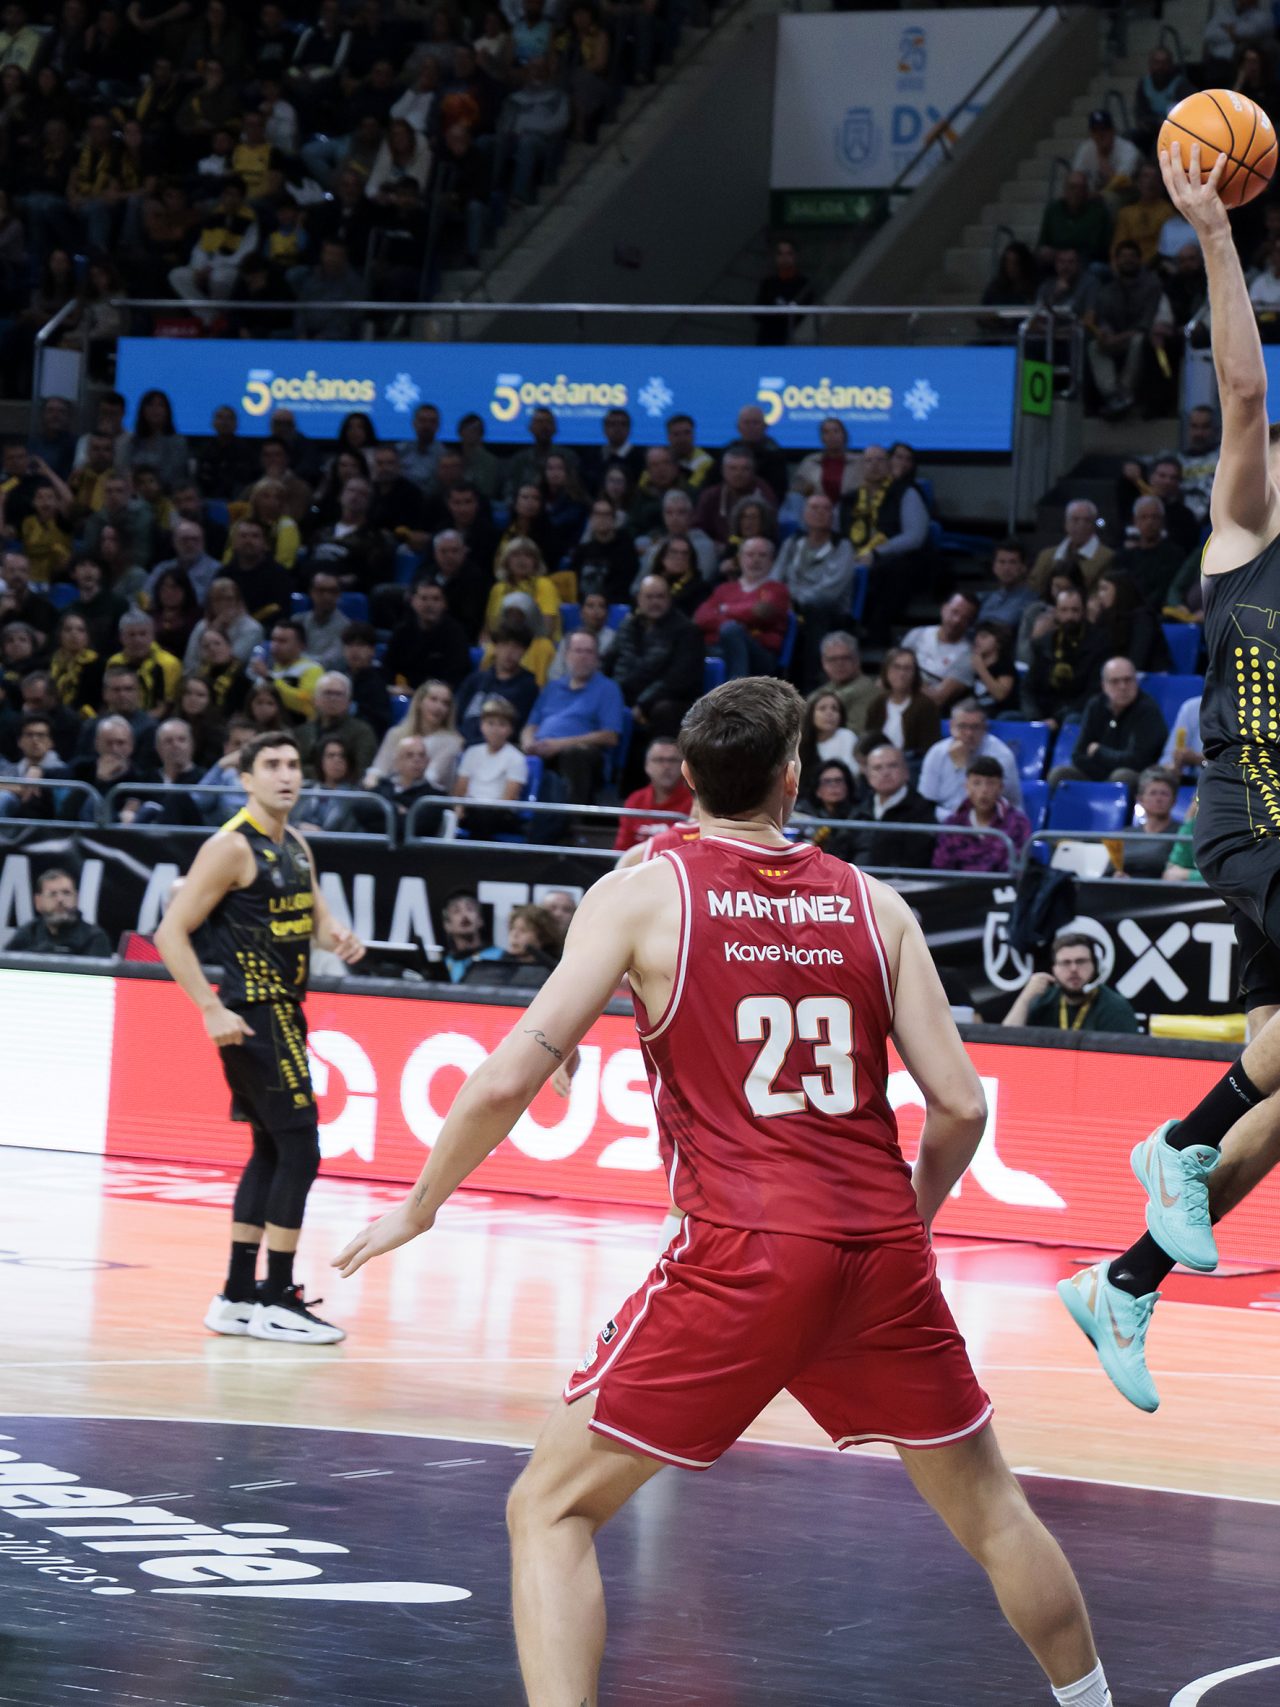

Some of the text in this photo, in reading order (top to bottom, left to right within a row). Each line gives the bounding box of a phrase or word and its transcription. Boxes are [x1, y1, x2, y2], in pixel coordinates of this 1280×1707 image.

[707, 890, 855, 924] MARTÍNEZ
[724, 941, 844, 965] Kave Home
[735, 993, 860, 1119] 23
